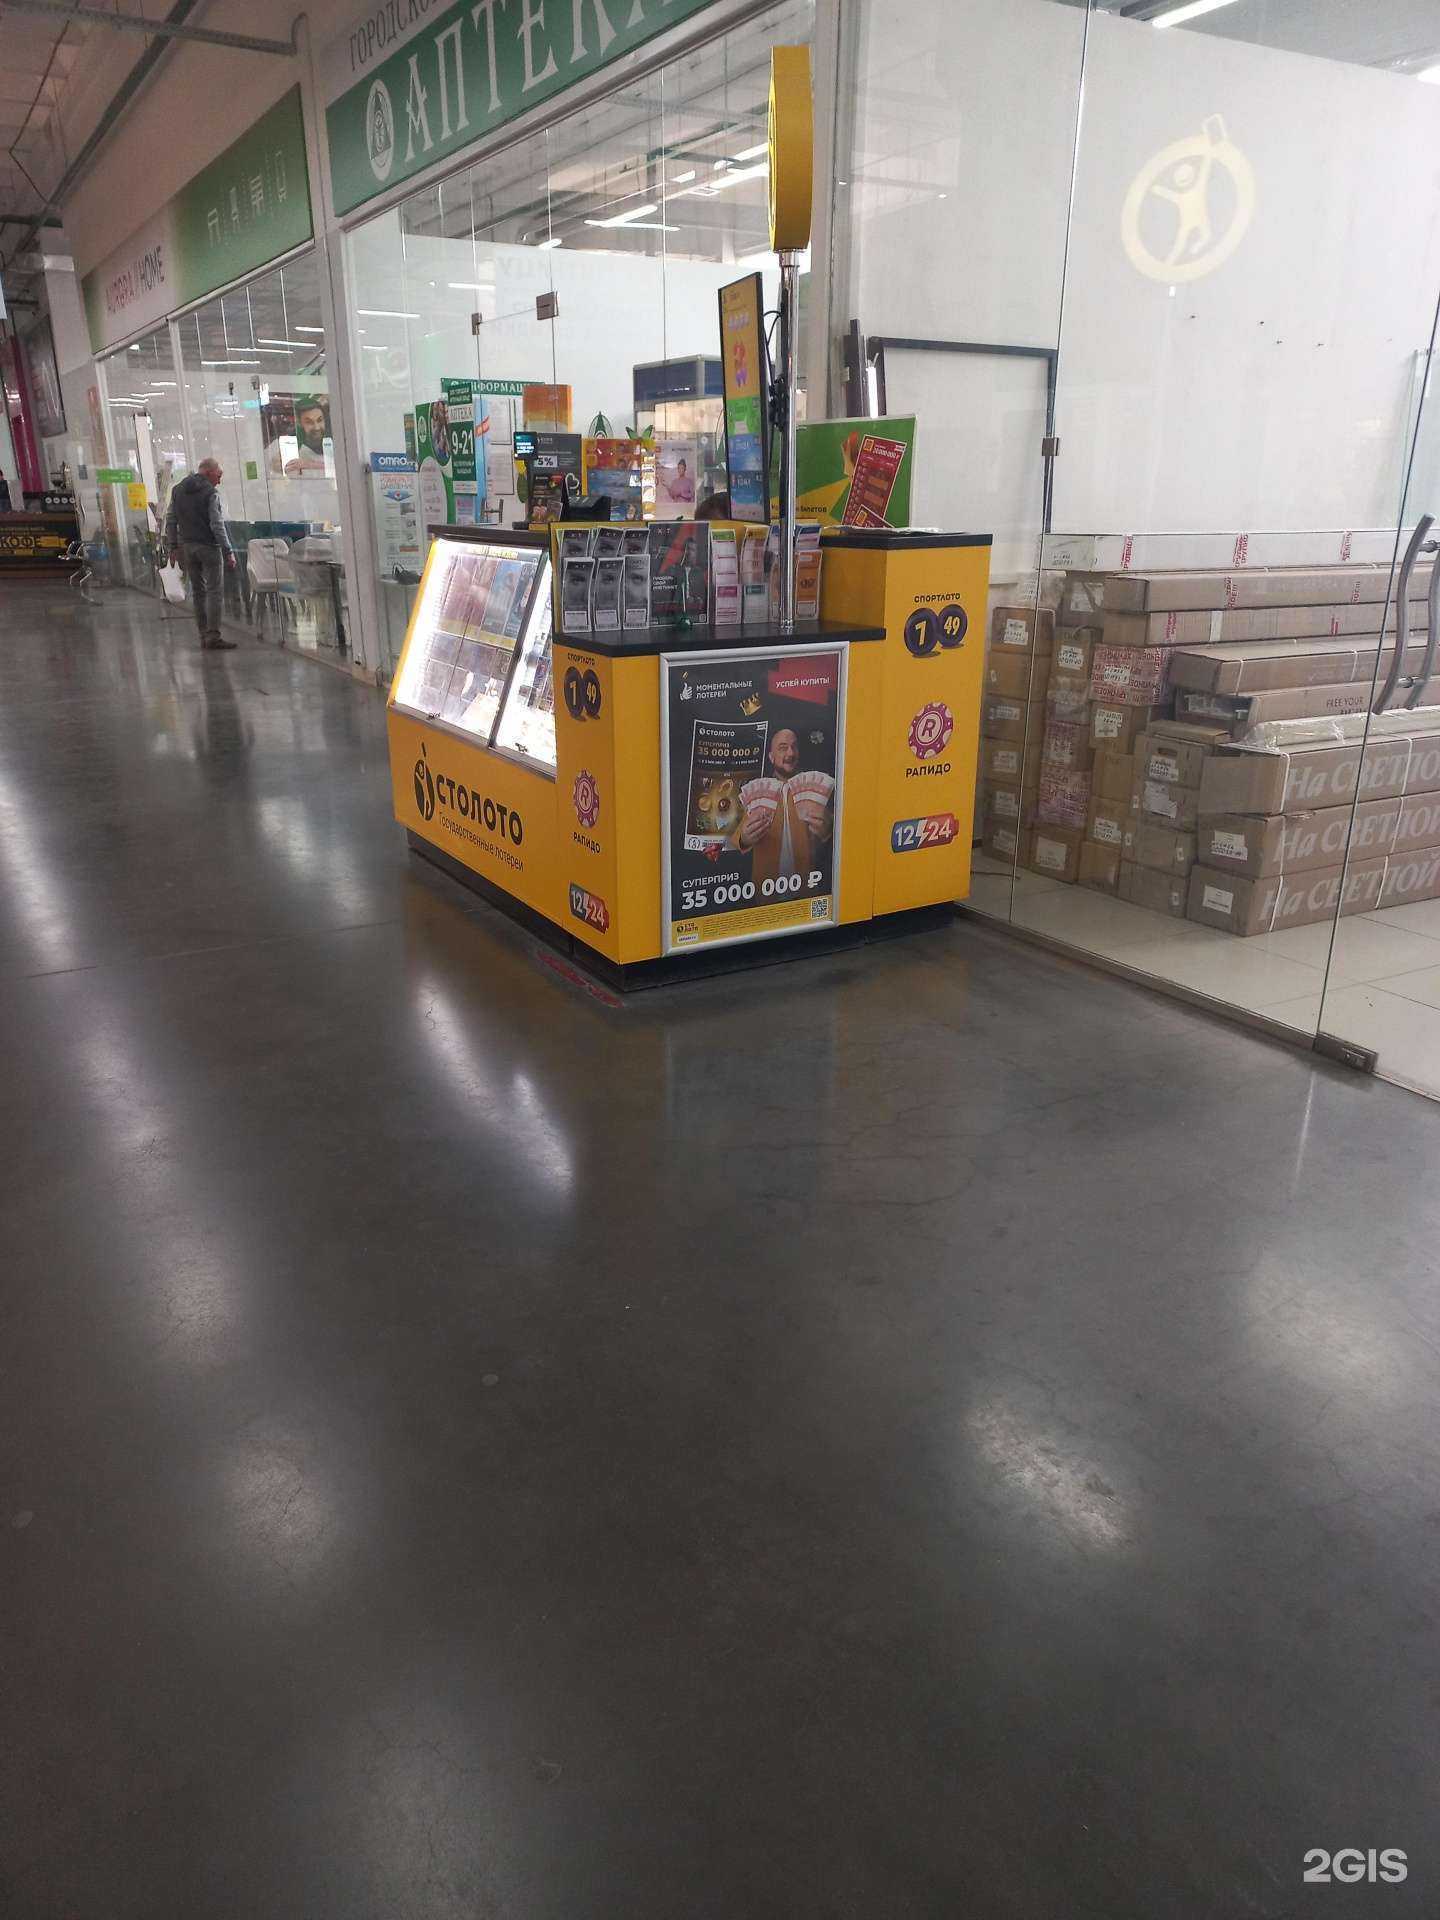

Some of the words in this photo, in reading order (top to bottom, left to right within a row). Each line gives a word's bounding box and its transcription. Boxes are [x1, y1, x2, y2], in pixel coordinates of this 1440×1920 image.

[404, 0, 673, 163] АПТЕК
[914, 592, 961, 604] СПОРТЛОТО
[914, 620, 927, 647] 7
[943, 615, 960, 636] 49
[905, 763, 951, 778] РАПИДО
[436, 774, 523, 846] СТОЛОТО
[572, 831, 601, 855] РАПИДО
[895, 824, 914, 848] 12
[927, 822, 952, 843] 24
[495, 845, 524, 873] лотереи
[681, 889, 708, 910] 35
[713, 881, 756, 905] 000
[761, 873, 802, 896] 000
[682, 872, 740, 889] СУПЕРПРИЗ
